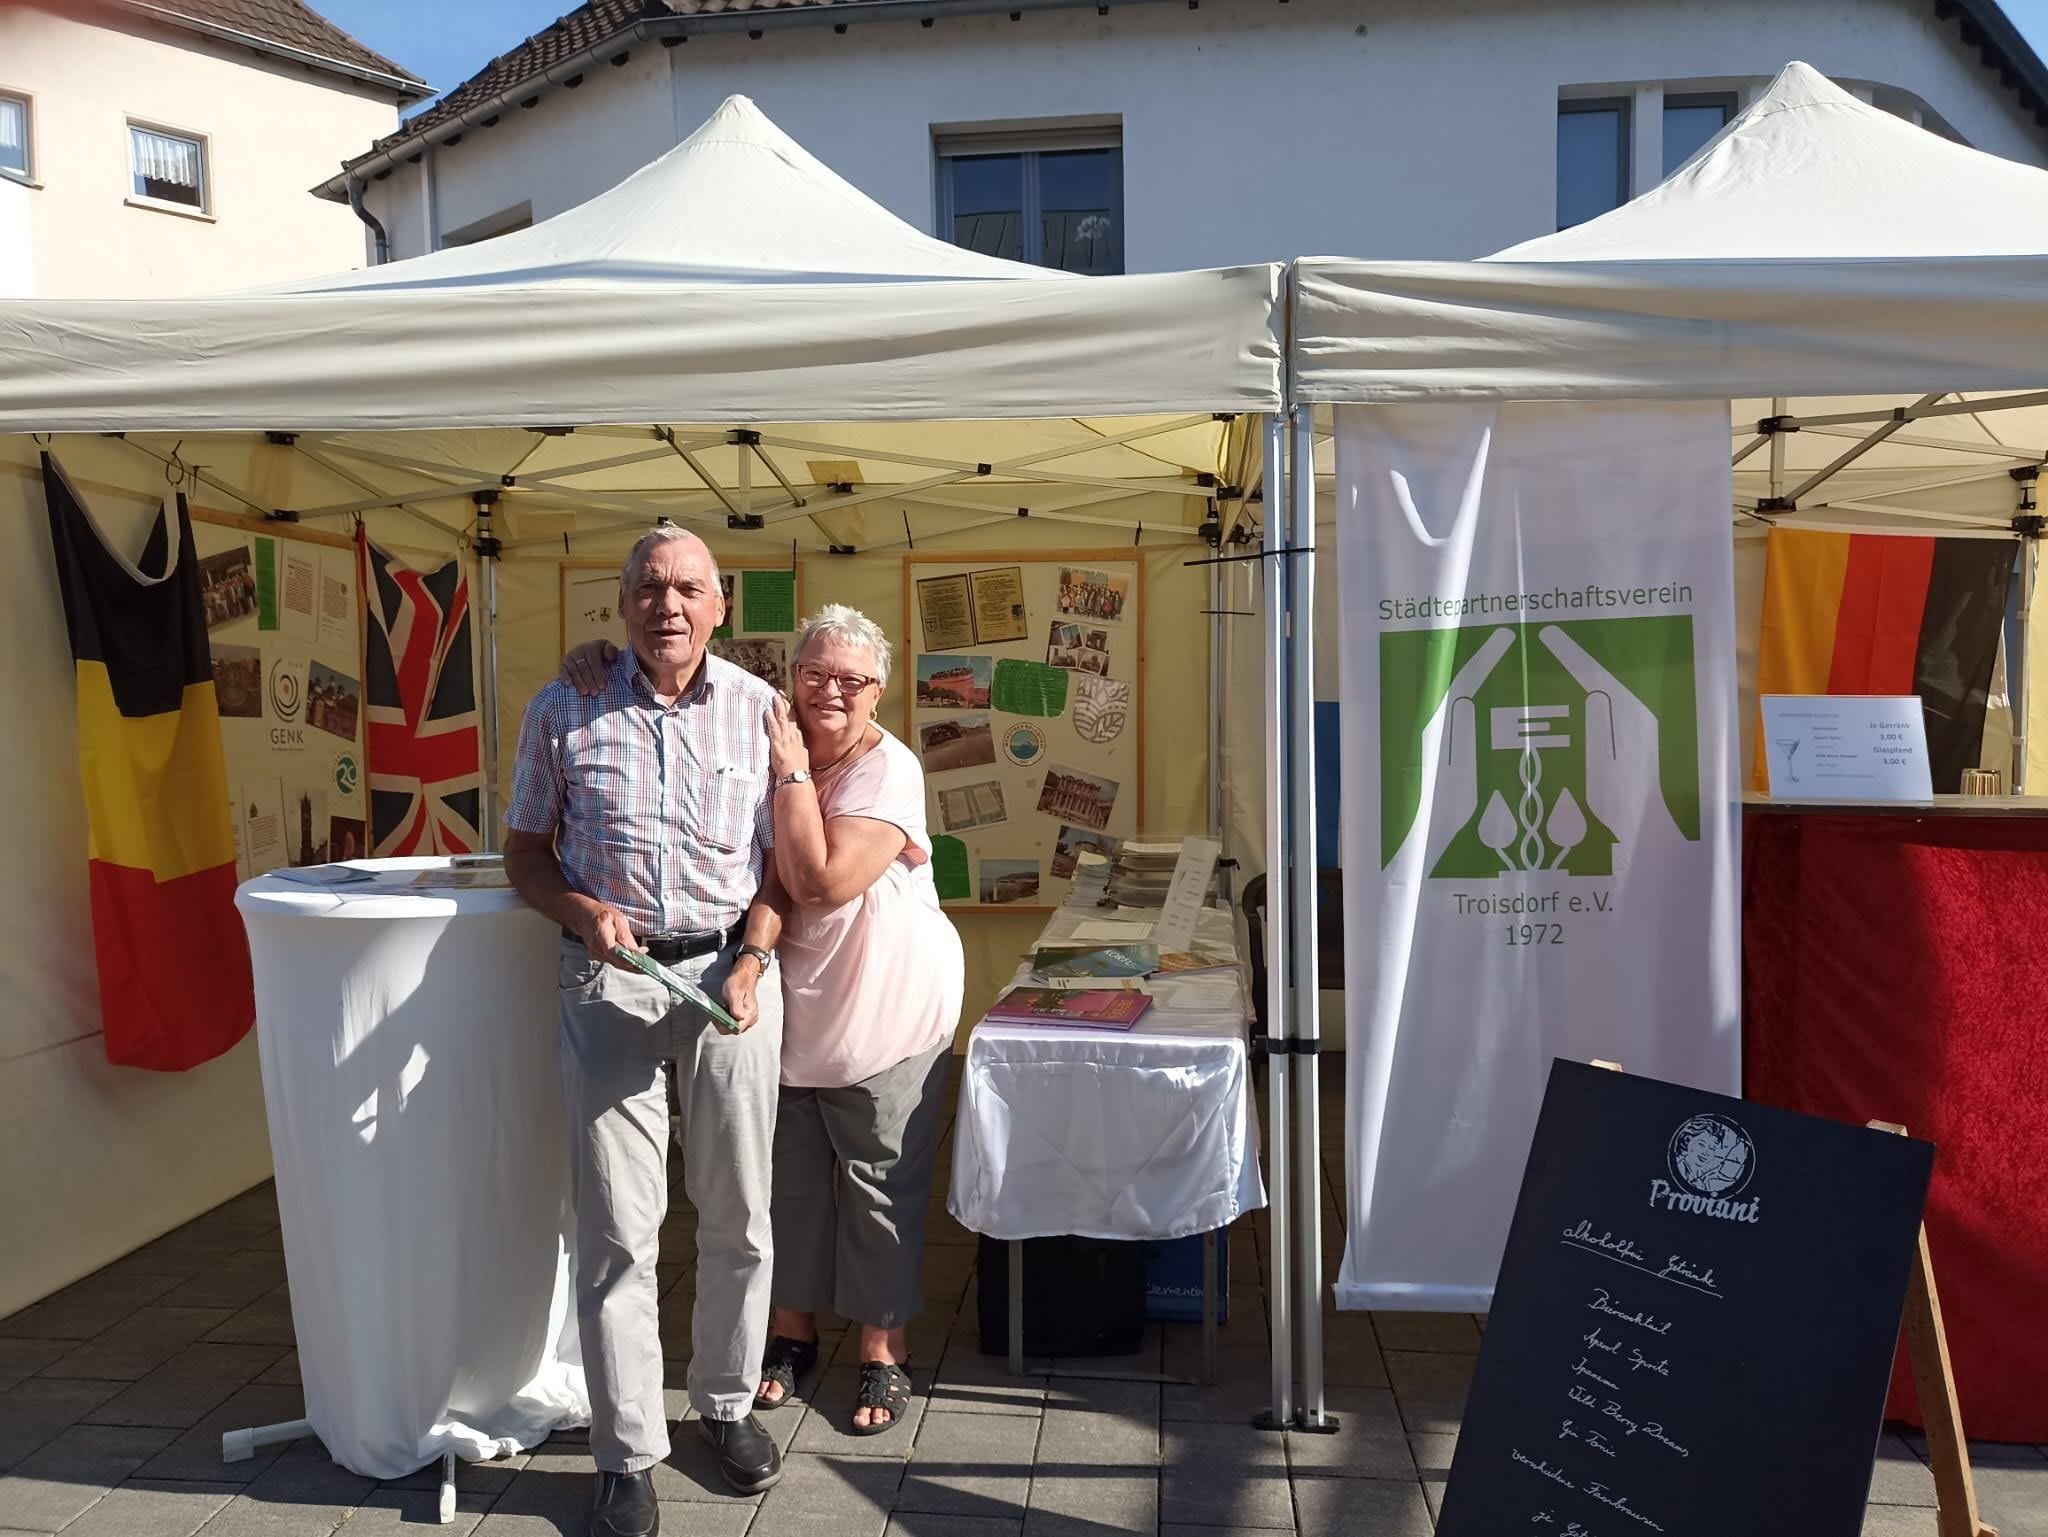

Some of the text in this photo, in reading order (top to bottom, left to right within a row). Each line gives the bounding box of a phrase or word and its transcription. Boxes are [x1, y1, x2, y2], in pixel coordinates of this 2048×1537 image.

[1378, 581, 1693, 621] Städtepartnerschaftsverein
[270, 728, 304, 745] GENK
[1452, 890, 1614, 915] Troisdorf e.V.
[1506, 922, 1565, 947] 1972
[1649, 1178, 1762, 1224] Proviant
[1627, 1348, 1670, 1377] Spritz
[1567, 1384, 1596, 1409] Wild
[1601, 1399, 1639, 1436] Berry
[1585, 1429, 1618, 1458] Tonic
